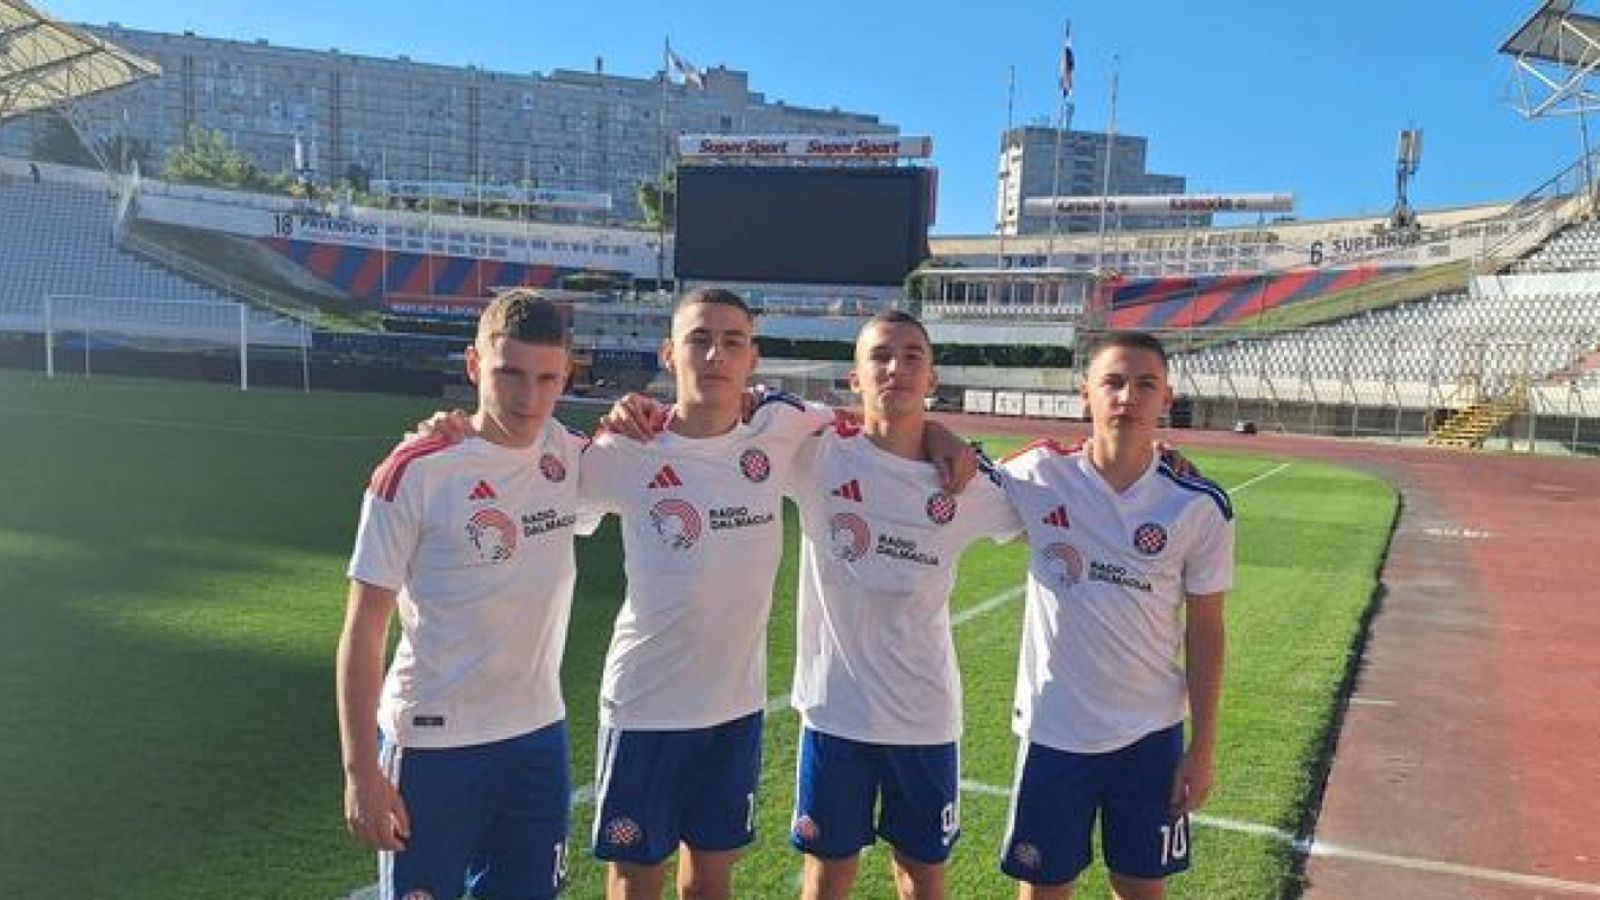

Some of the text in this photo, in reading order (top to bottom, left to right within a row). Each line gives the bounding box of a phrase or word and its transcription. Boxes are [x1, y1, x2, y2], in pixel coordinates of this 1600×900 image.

[699, 138, 900, 154] SuperSport SuperSport
[273, 214, 293, 235] 18
[1310, 240, 1323, 264] 6
[709, 506, 748, 520] RADIO
[1160, 817, 1187, 865] 10
